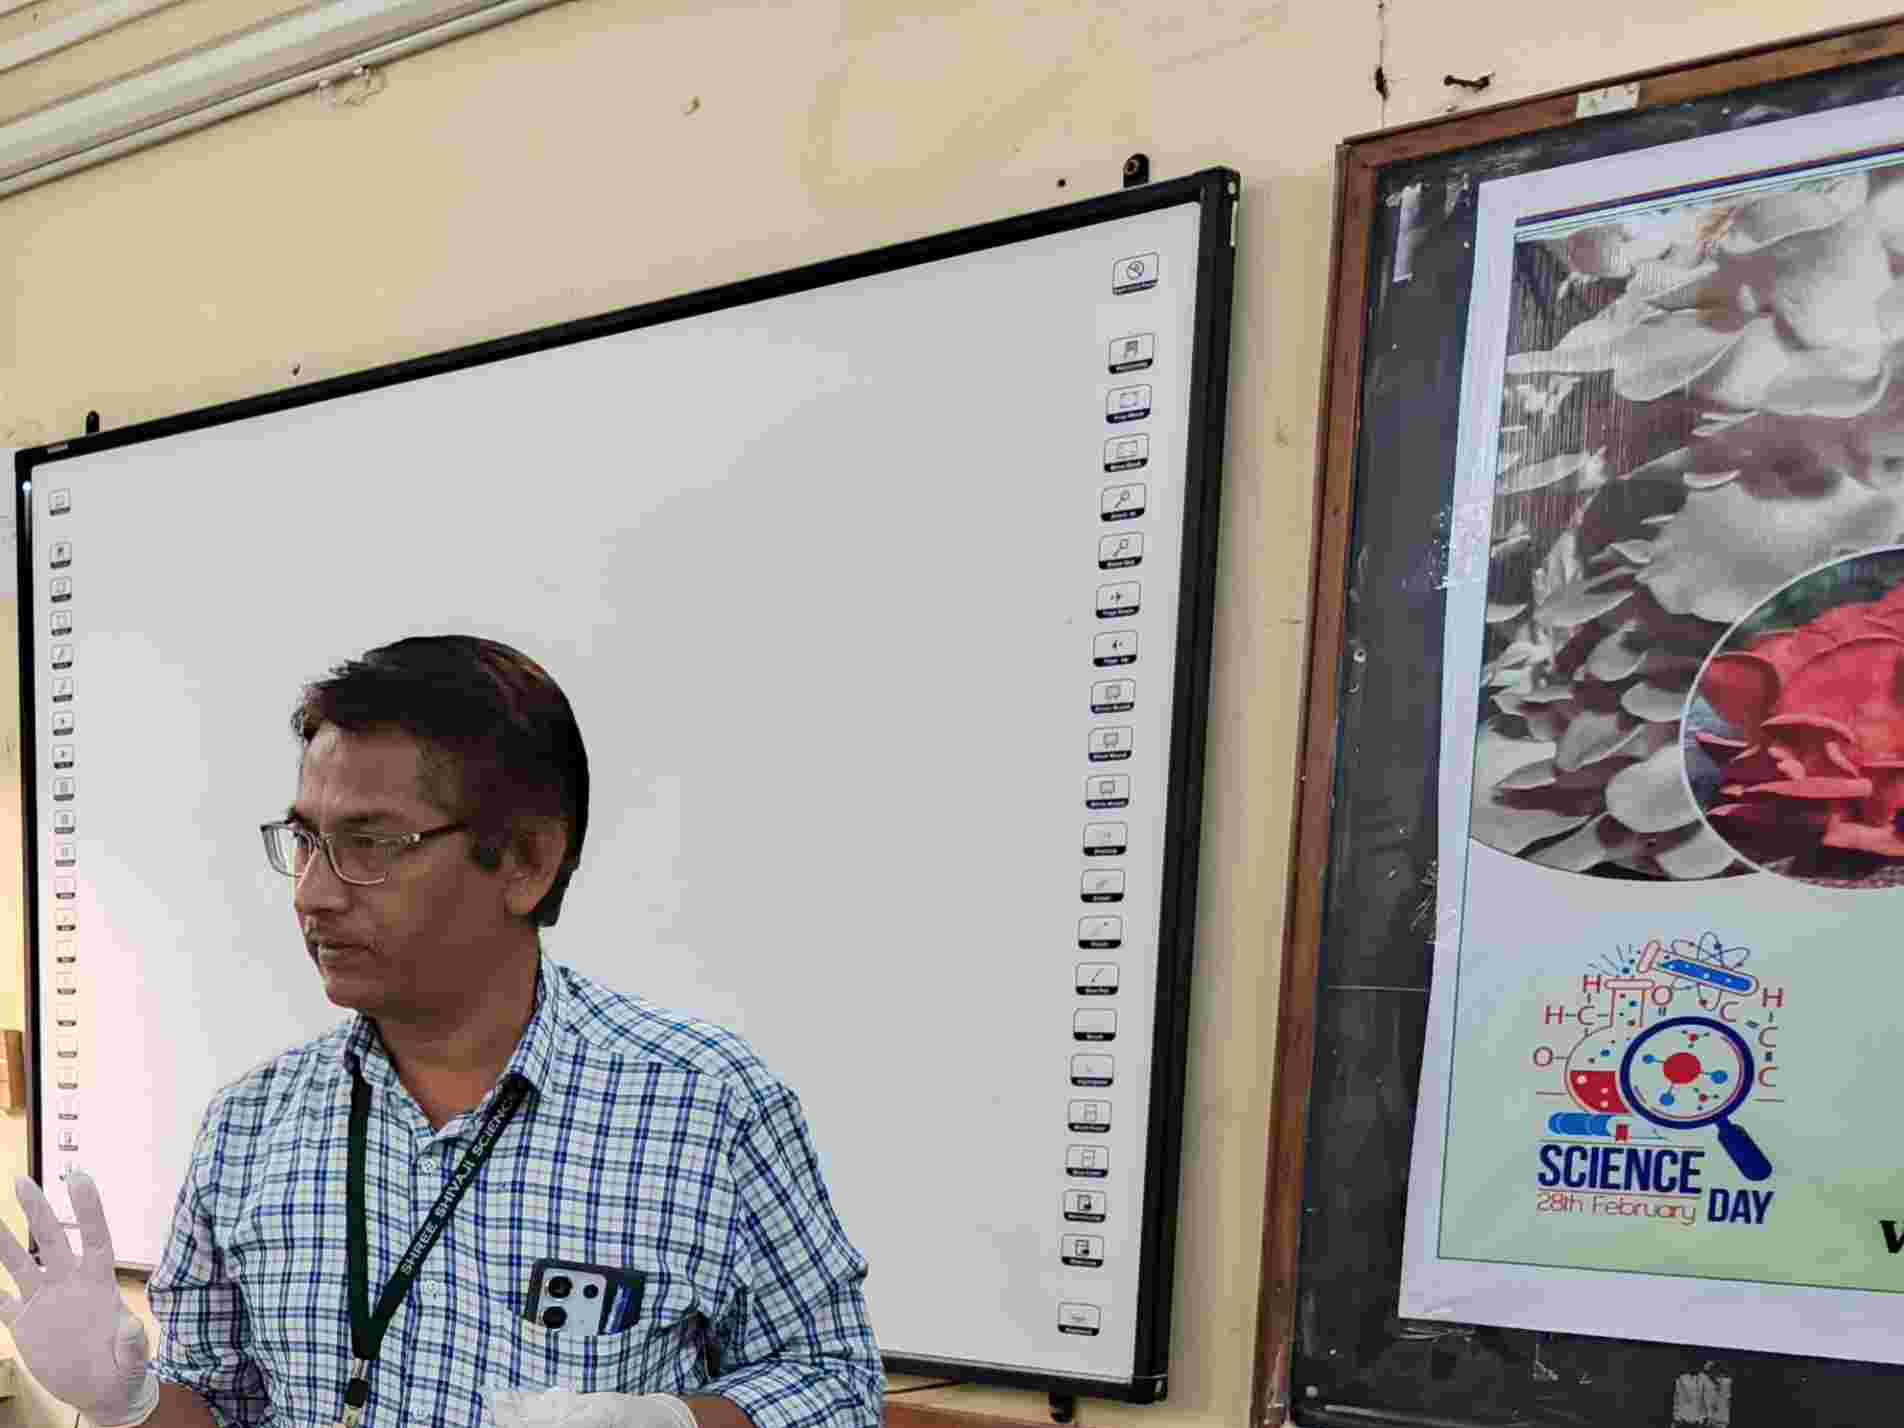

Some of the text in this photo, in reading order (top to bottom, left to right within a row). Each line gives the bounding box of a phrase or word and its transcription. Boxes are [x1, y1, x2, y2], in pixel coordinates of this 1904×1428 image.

[1537, 1143, 1705, 1194] SCIENCE
[400, 1222, 438, 1275] SHREE
[436, 1159, 475, 1218] SHIVAJI
[1591, 1195, 1696, 1225] February
[1707, 1188, 1774, 1224] DAY
